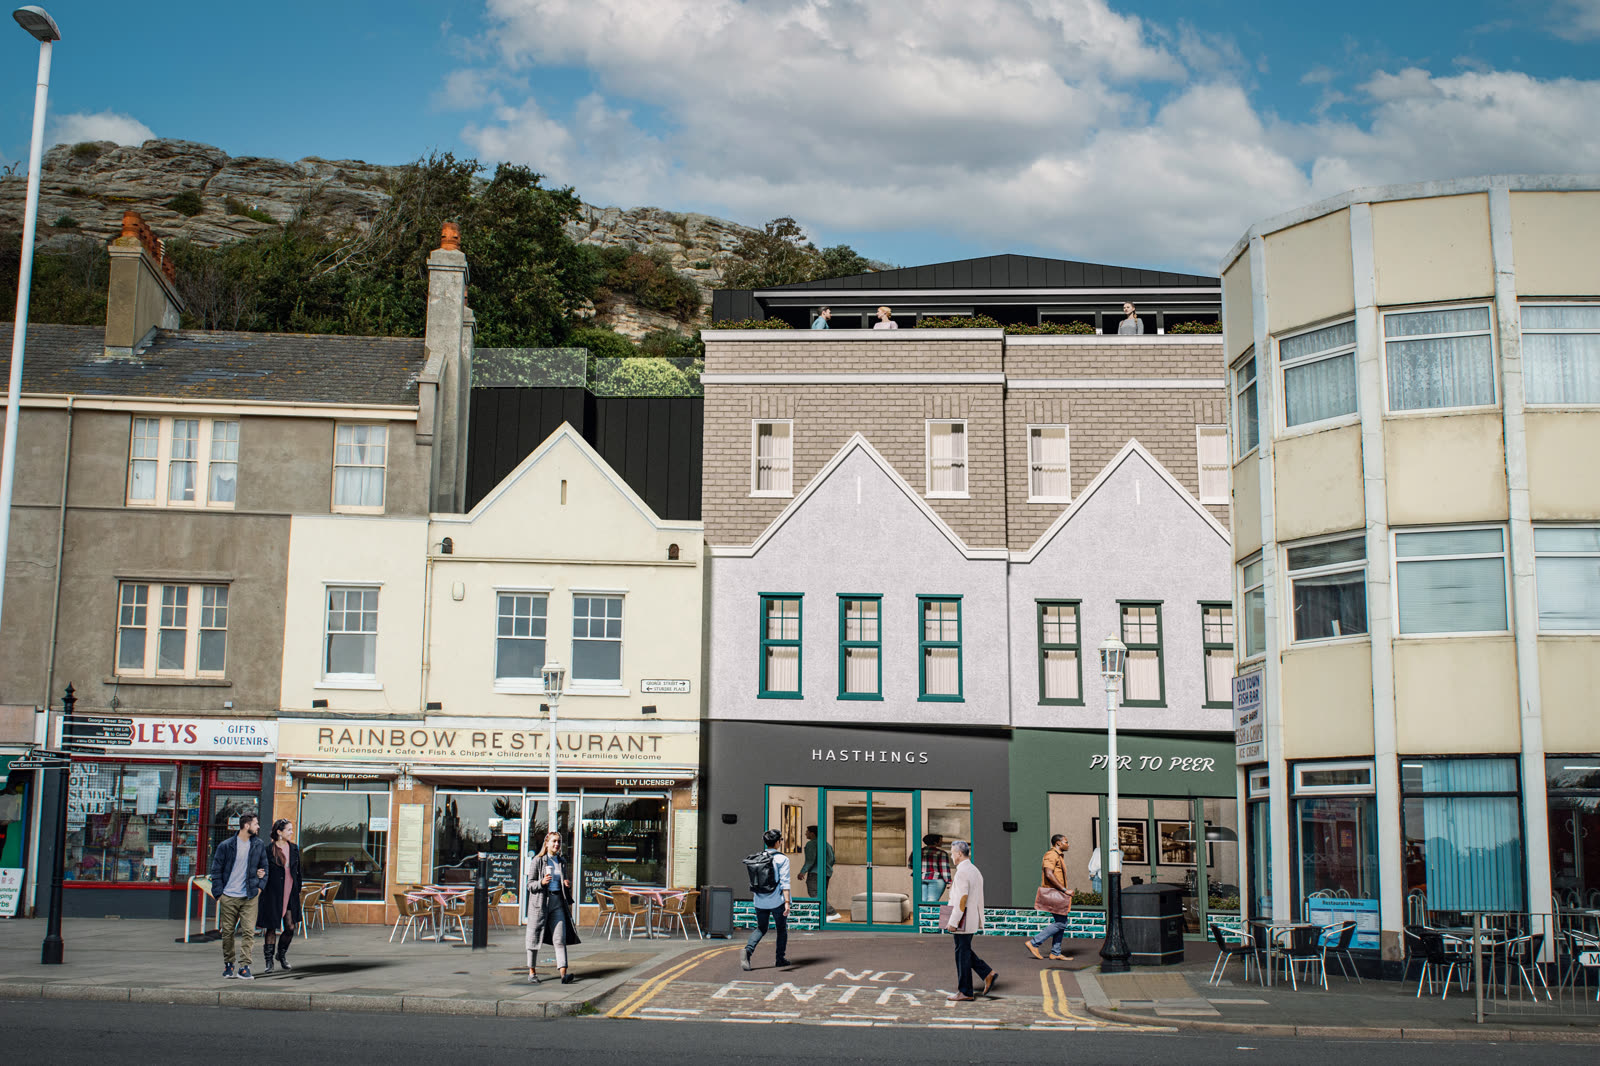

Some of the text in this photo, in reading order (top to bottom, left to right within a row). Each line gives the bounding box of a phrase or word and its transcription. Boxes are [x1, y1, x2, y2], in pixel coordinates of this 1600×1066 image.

[1236, 674, 1260, 692] OLD TOWN
[1238, 688, 1259, 706] FISH BAR
[131, 724, 198, 744] LEYS
[228, 724, 256, 734] GIFTS
[1235, 727, 1246, 744] FISH
[1249, 723, 1262, 741] CHIPS
[213, 736, 269, 746] SOUVENIRS
[318, 728, 663, 752] RAINBOW RESTAURANT
[812, 749, 928, 764] HASTHINGS
[1246, 745, 1260, 758] CREAM
[70, 763, 98, 774] END
[1089, 754, 1215, 772] PIR TO PEER
[70, 777, 88, 786] OF
[68, 802, 104, 813] SALE
[824, 968, 914, 982] NO
[710, 980, 961, 1008] ENTRY
